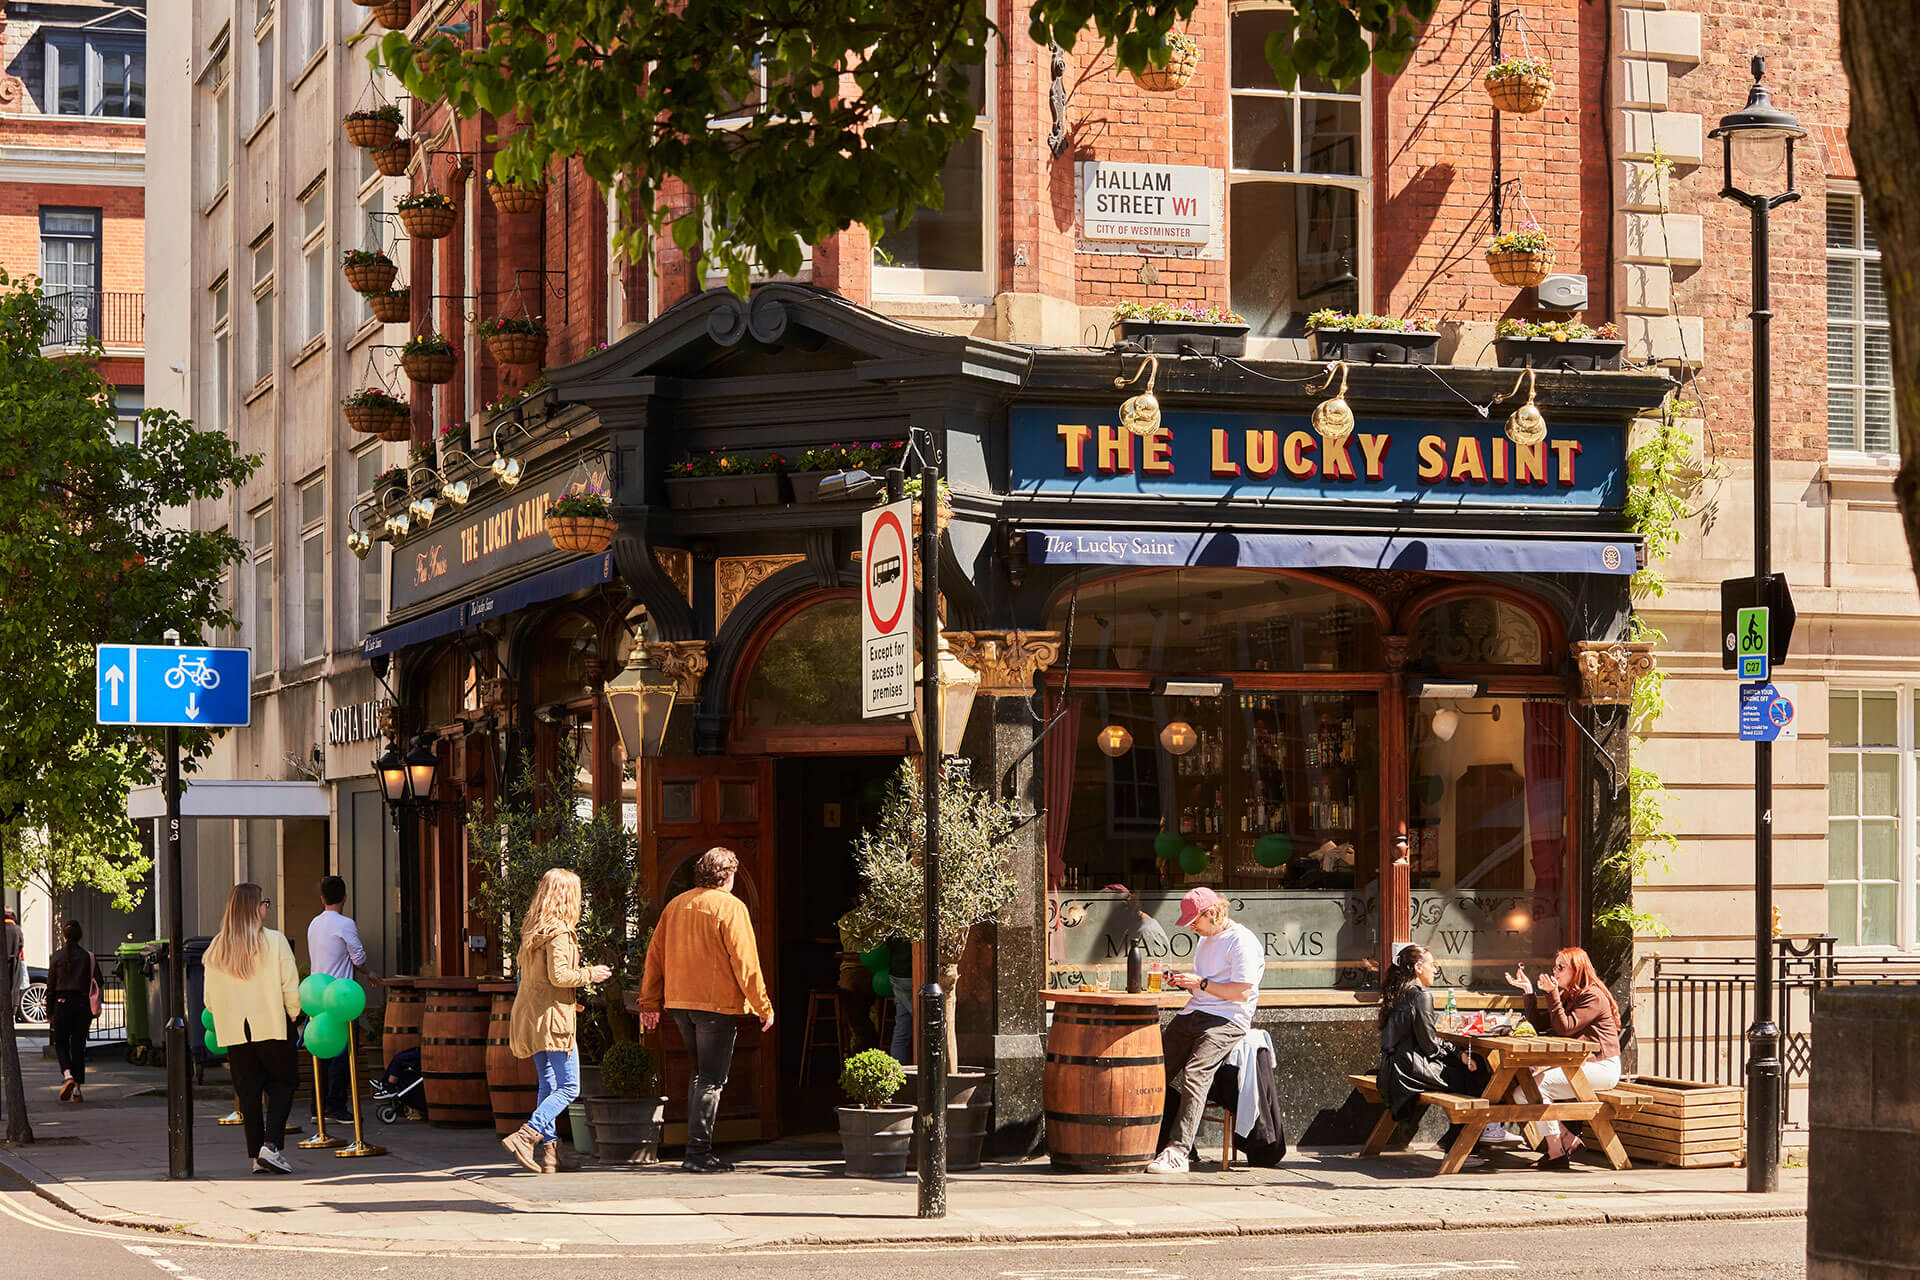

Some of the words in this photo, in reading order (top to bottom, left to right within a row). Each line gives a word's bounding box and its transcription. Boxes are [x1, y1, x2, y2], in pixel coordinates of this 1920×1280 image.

[1095, 169, 1171, 192] HALLAM
[1096, 194, 1165, 215] STREET
[1172, 197, 1197, 217] W1
[1096, 224, 1115, 234] CITY
[1118, 225, 1129, 235] OF
[1131, 226, 1191, 238] WESTMINSTER
[1057, 424, 1174, 474] THE
[1211, 429, 1393, 480] LUCKY
[1418, 435, 1582, 486] SAINT
[461, 524, 478, 565] THE
[483, 507, 514, 555] LUCKY
[517, 492, 550, 541] SAINT
[1044, 535, 1073, 553] The
[1076, 535, 1128, 559] Lucky
[1131, 537, 1175, 556] Saint
[870, 644, 893, 661] Except
[895, 641, 904, 656] for
[872, 666, 894, 681] access
[896, 662, 903, 676] to
[1745, 662, 1760, 672] C27
[873, 683, 902, 703] premises
[328, 703, 360, 745] SOFIA
[1762, 809, 1771, 824] 4
[1104, 932, 1201, 958] MASO
[1263, 931, 1323, 956] RMS
